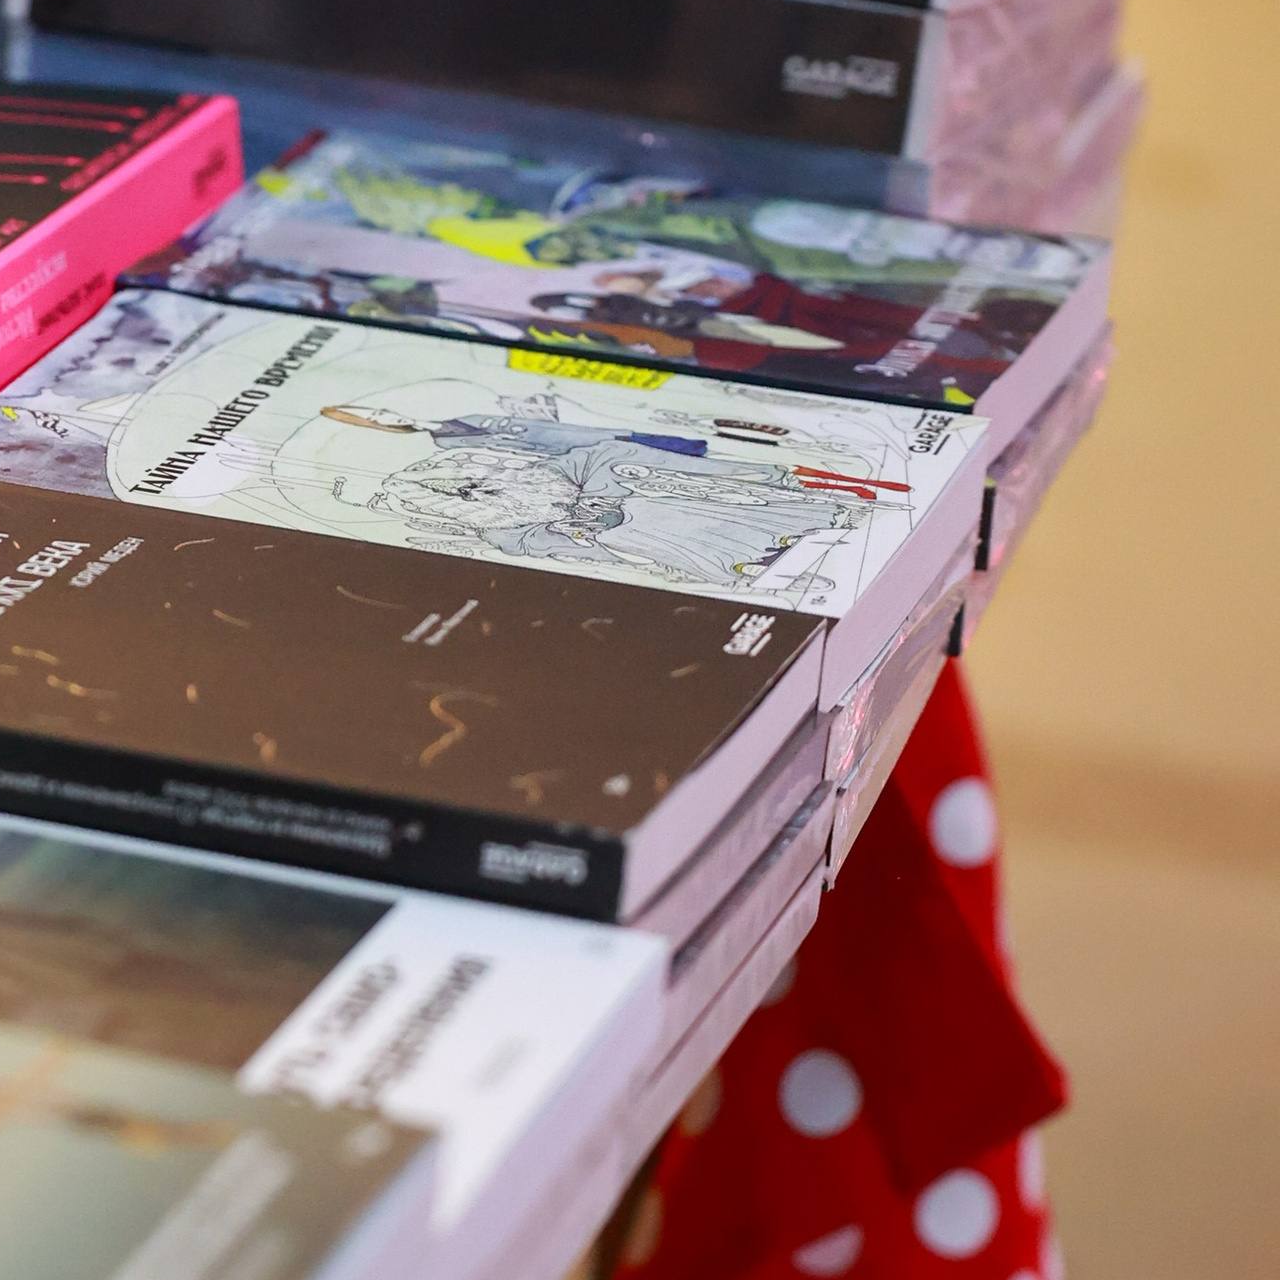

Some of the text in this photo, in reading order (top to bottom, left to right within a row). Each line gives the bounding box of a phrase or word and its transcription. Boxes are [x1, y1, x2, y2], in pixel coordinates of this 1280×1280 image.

[129, 450, 207, 495] ТАЙНА
[186, 389, 271, 447] НАШЕГО
[253, 325, 340, 387] ВРЕМЕНИ
[907, 411, 956, 455] GARAGE
[17, 538, 92, 579] ВЕКА
